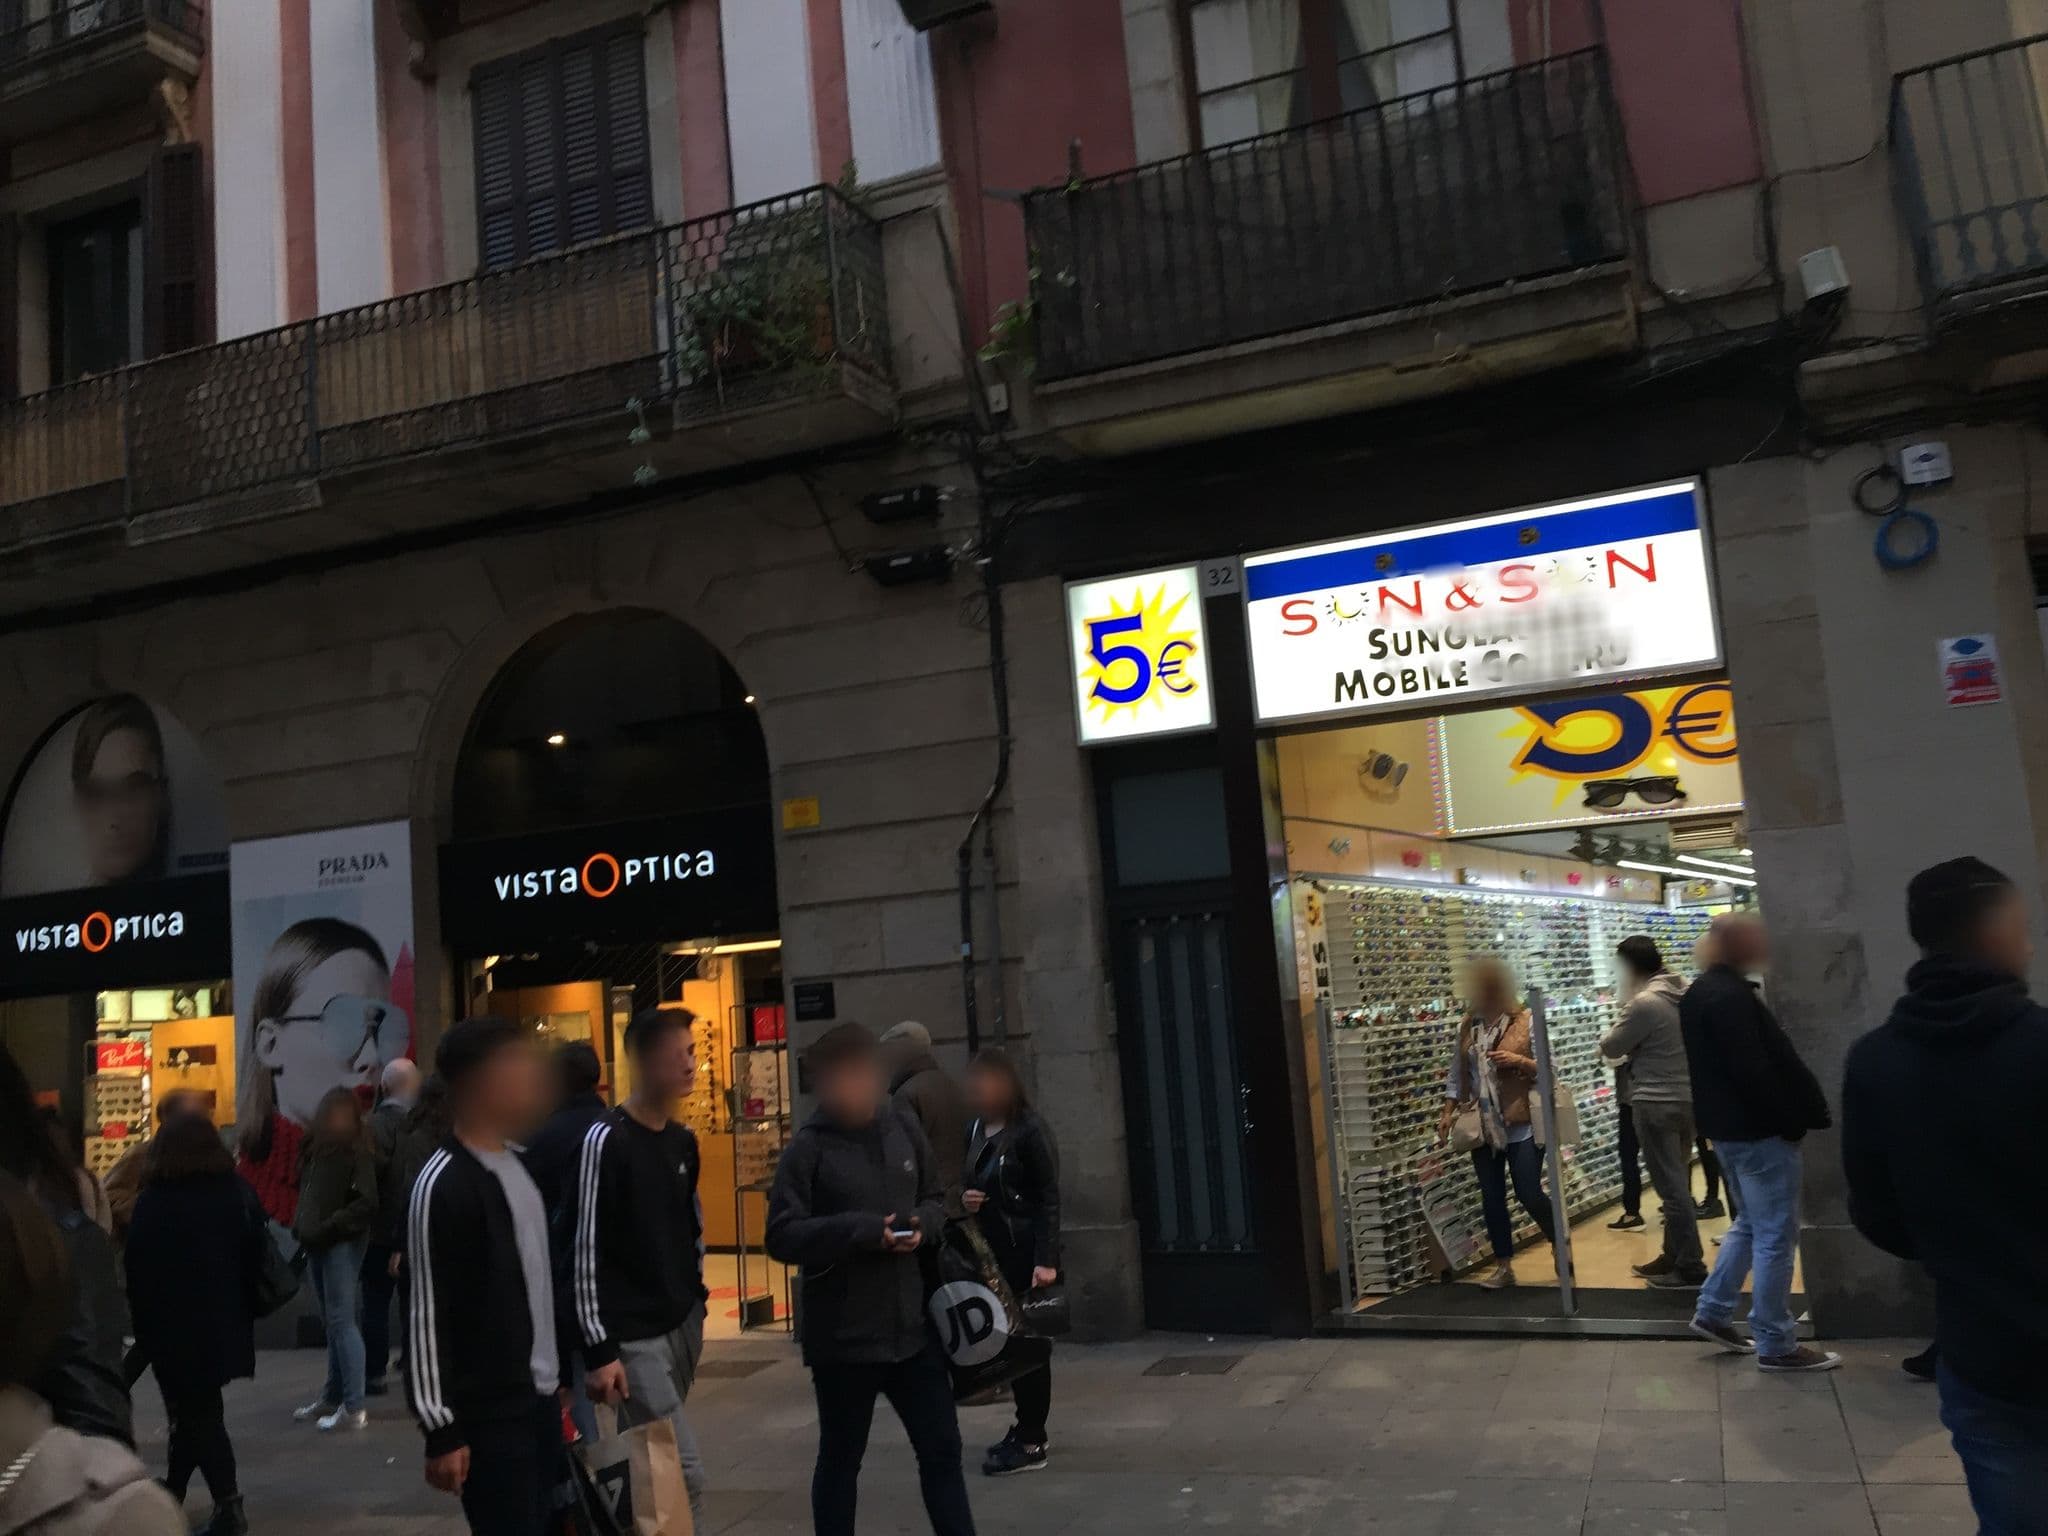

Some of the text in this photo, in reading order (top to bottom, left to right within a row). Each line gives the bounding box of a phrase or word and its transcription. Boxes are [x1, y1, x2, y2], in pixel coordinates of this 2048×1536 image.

[1208, 566, 1233, 586] 32
[1499, 543, 1657, 603] SN
[1084, 612, 1198, 704] 5€
[1333, 657, 1469, 703] MOBILE
[319, 851, 389, 876] PRADA
[946, 1296, 994, 1355] JD
